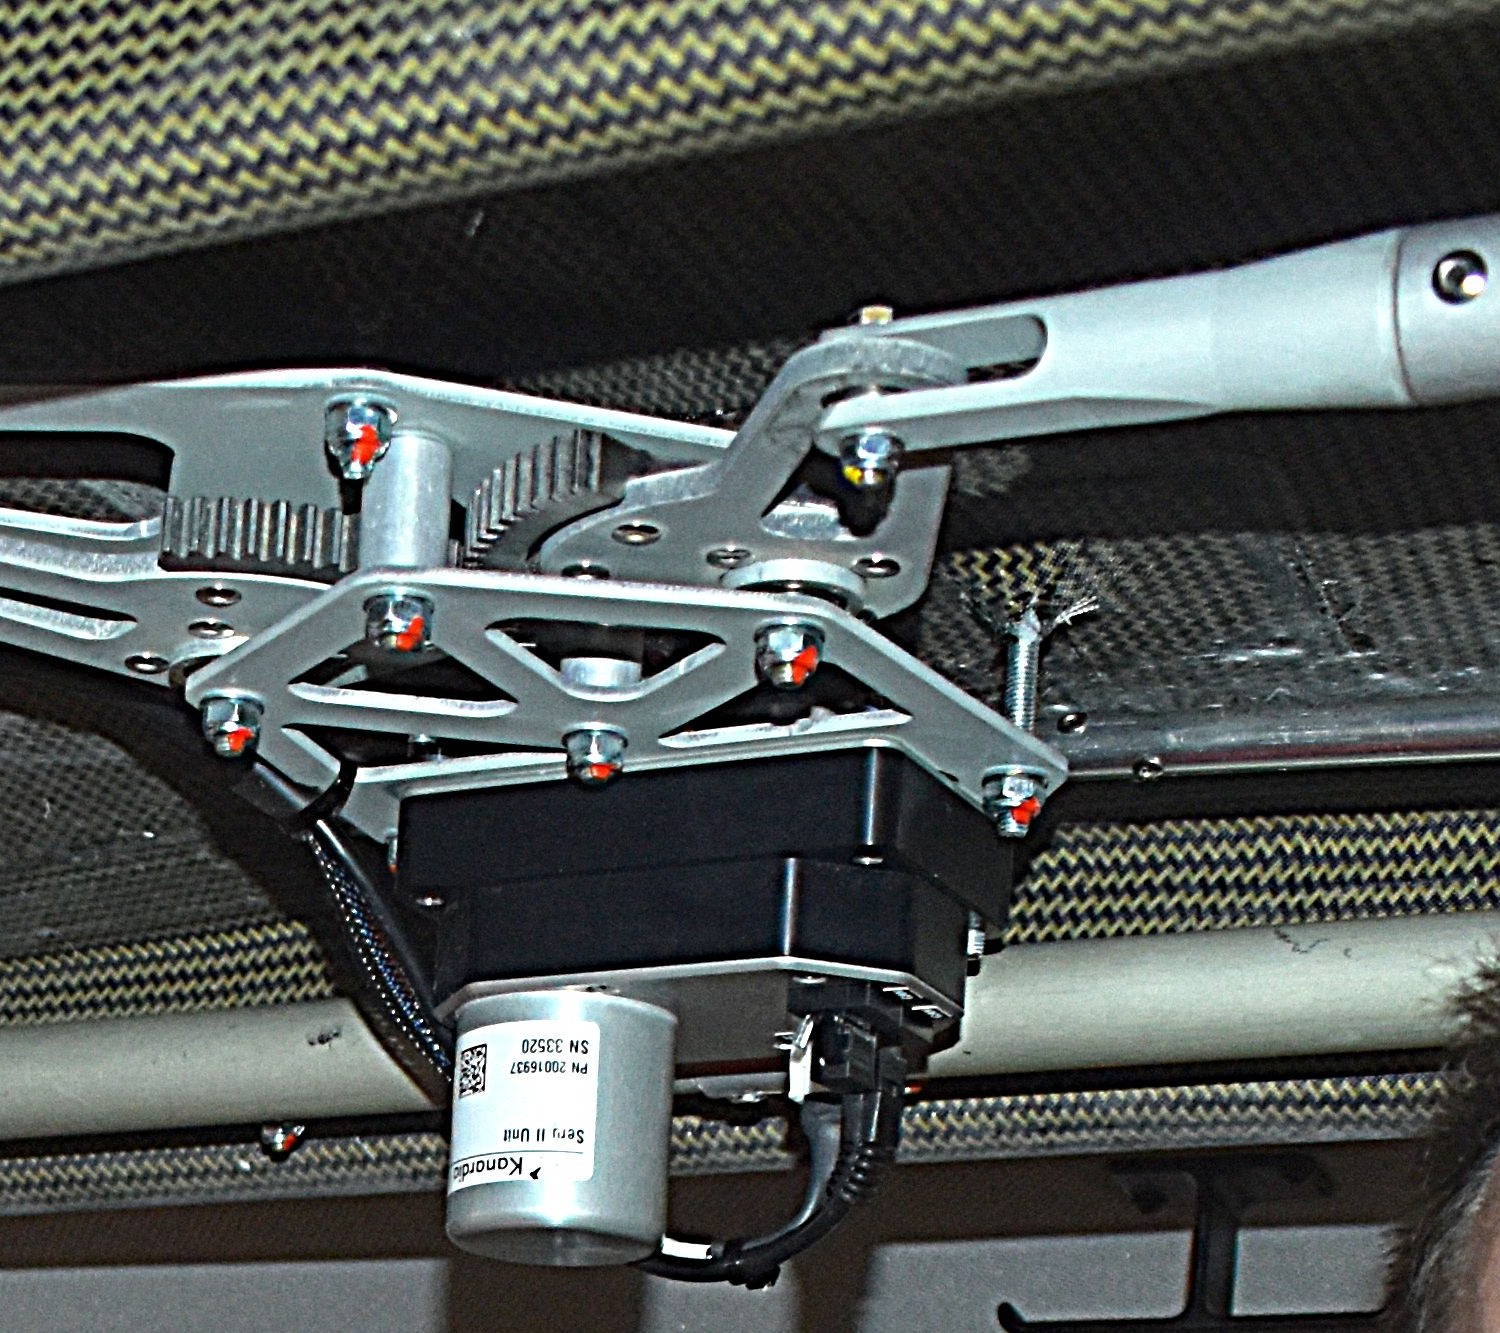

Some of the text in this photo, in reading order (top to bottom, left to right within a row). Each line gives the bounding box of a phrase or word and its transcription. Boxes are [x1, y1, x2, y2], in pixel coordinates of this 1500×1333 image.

[521, 1038, 589, 1054] SN 33520
[510, 1060, 588, 1075] PN 20016937
[503, 1128, 530, 1142] Unit
